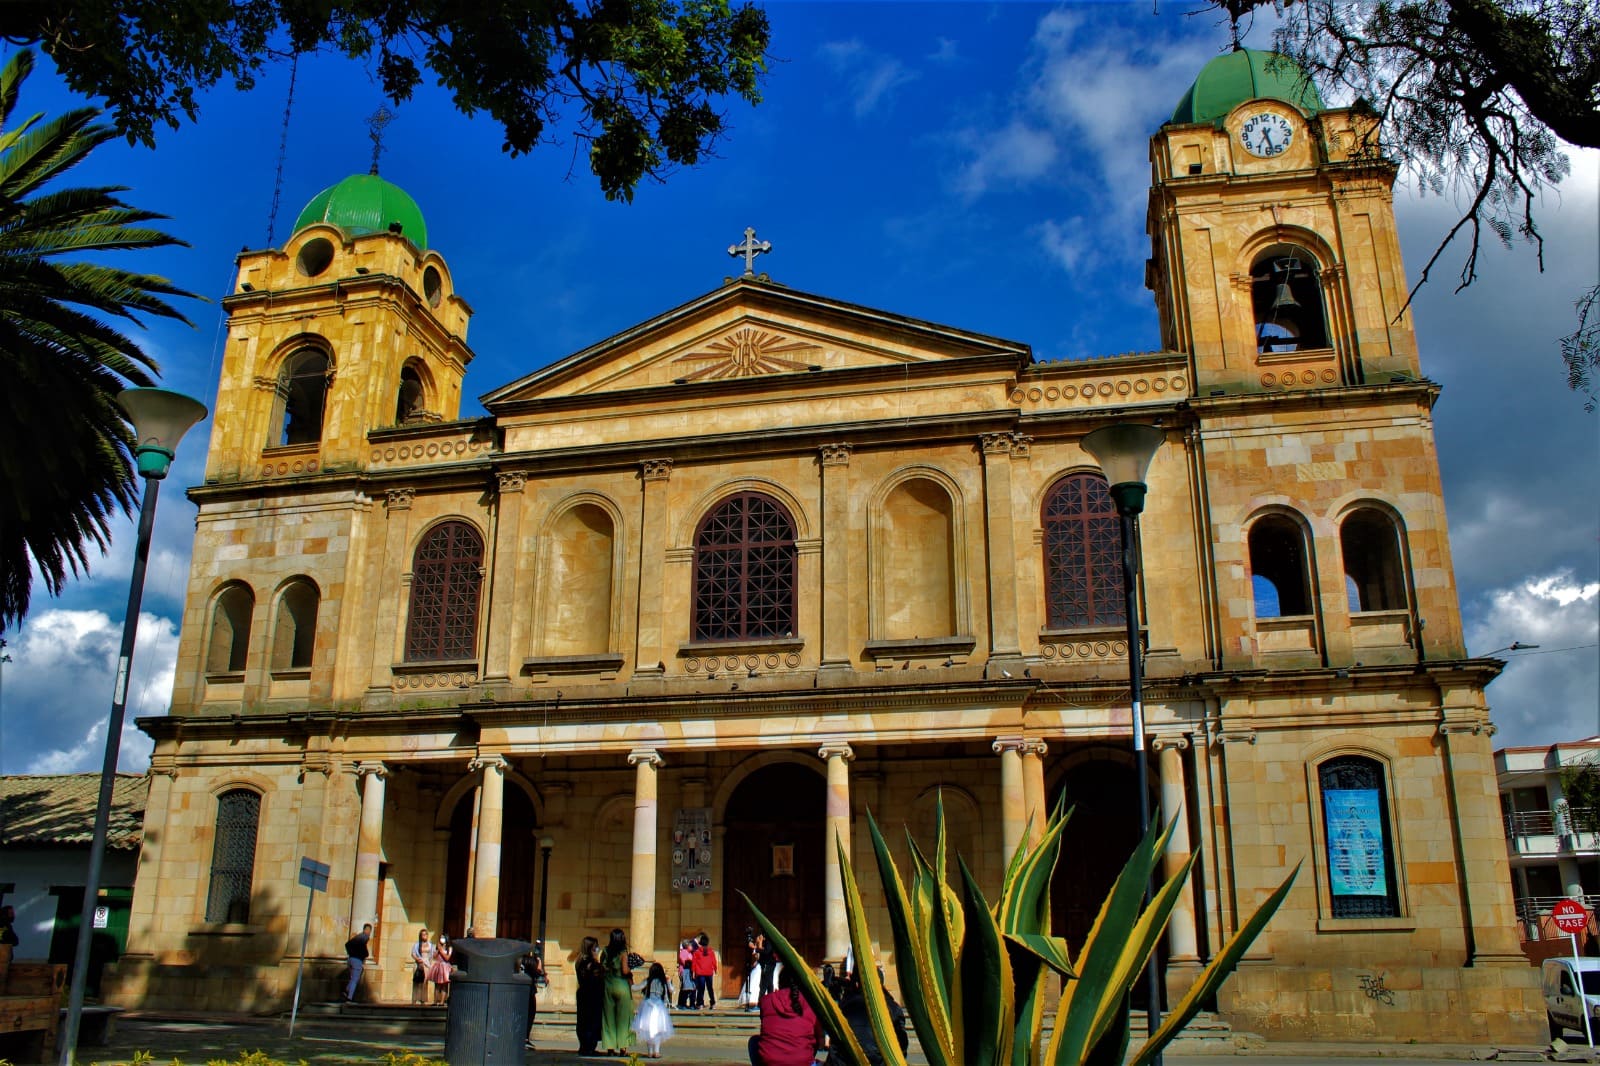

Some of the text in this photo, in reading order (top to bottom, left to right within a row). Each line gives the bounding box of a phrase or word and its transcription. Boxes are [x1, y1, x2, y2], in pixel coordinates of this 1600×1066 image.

[1251, 117, 1258, 125] 11
[1260, 113, 1270, 122] 12
[1272, 116, 1276, 124] 1
[1280, 120, 1286, 128] 2
[1284, 128, 1292, 136] 3
[1242, 132, 1248, 141] 9
[1245, 141, 1252, 149] 8
[1282, 138, 1289, 146] 4
[1265, 146, 1273, 156] 6
[1274, 145, 1283, 153] 5
[1562, 906, 1575, 914] NO
[1558, 919, 1584, 927] PASE
